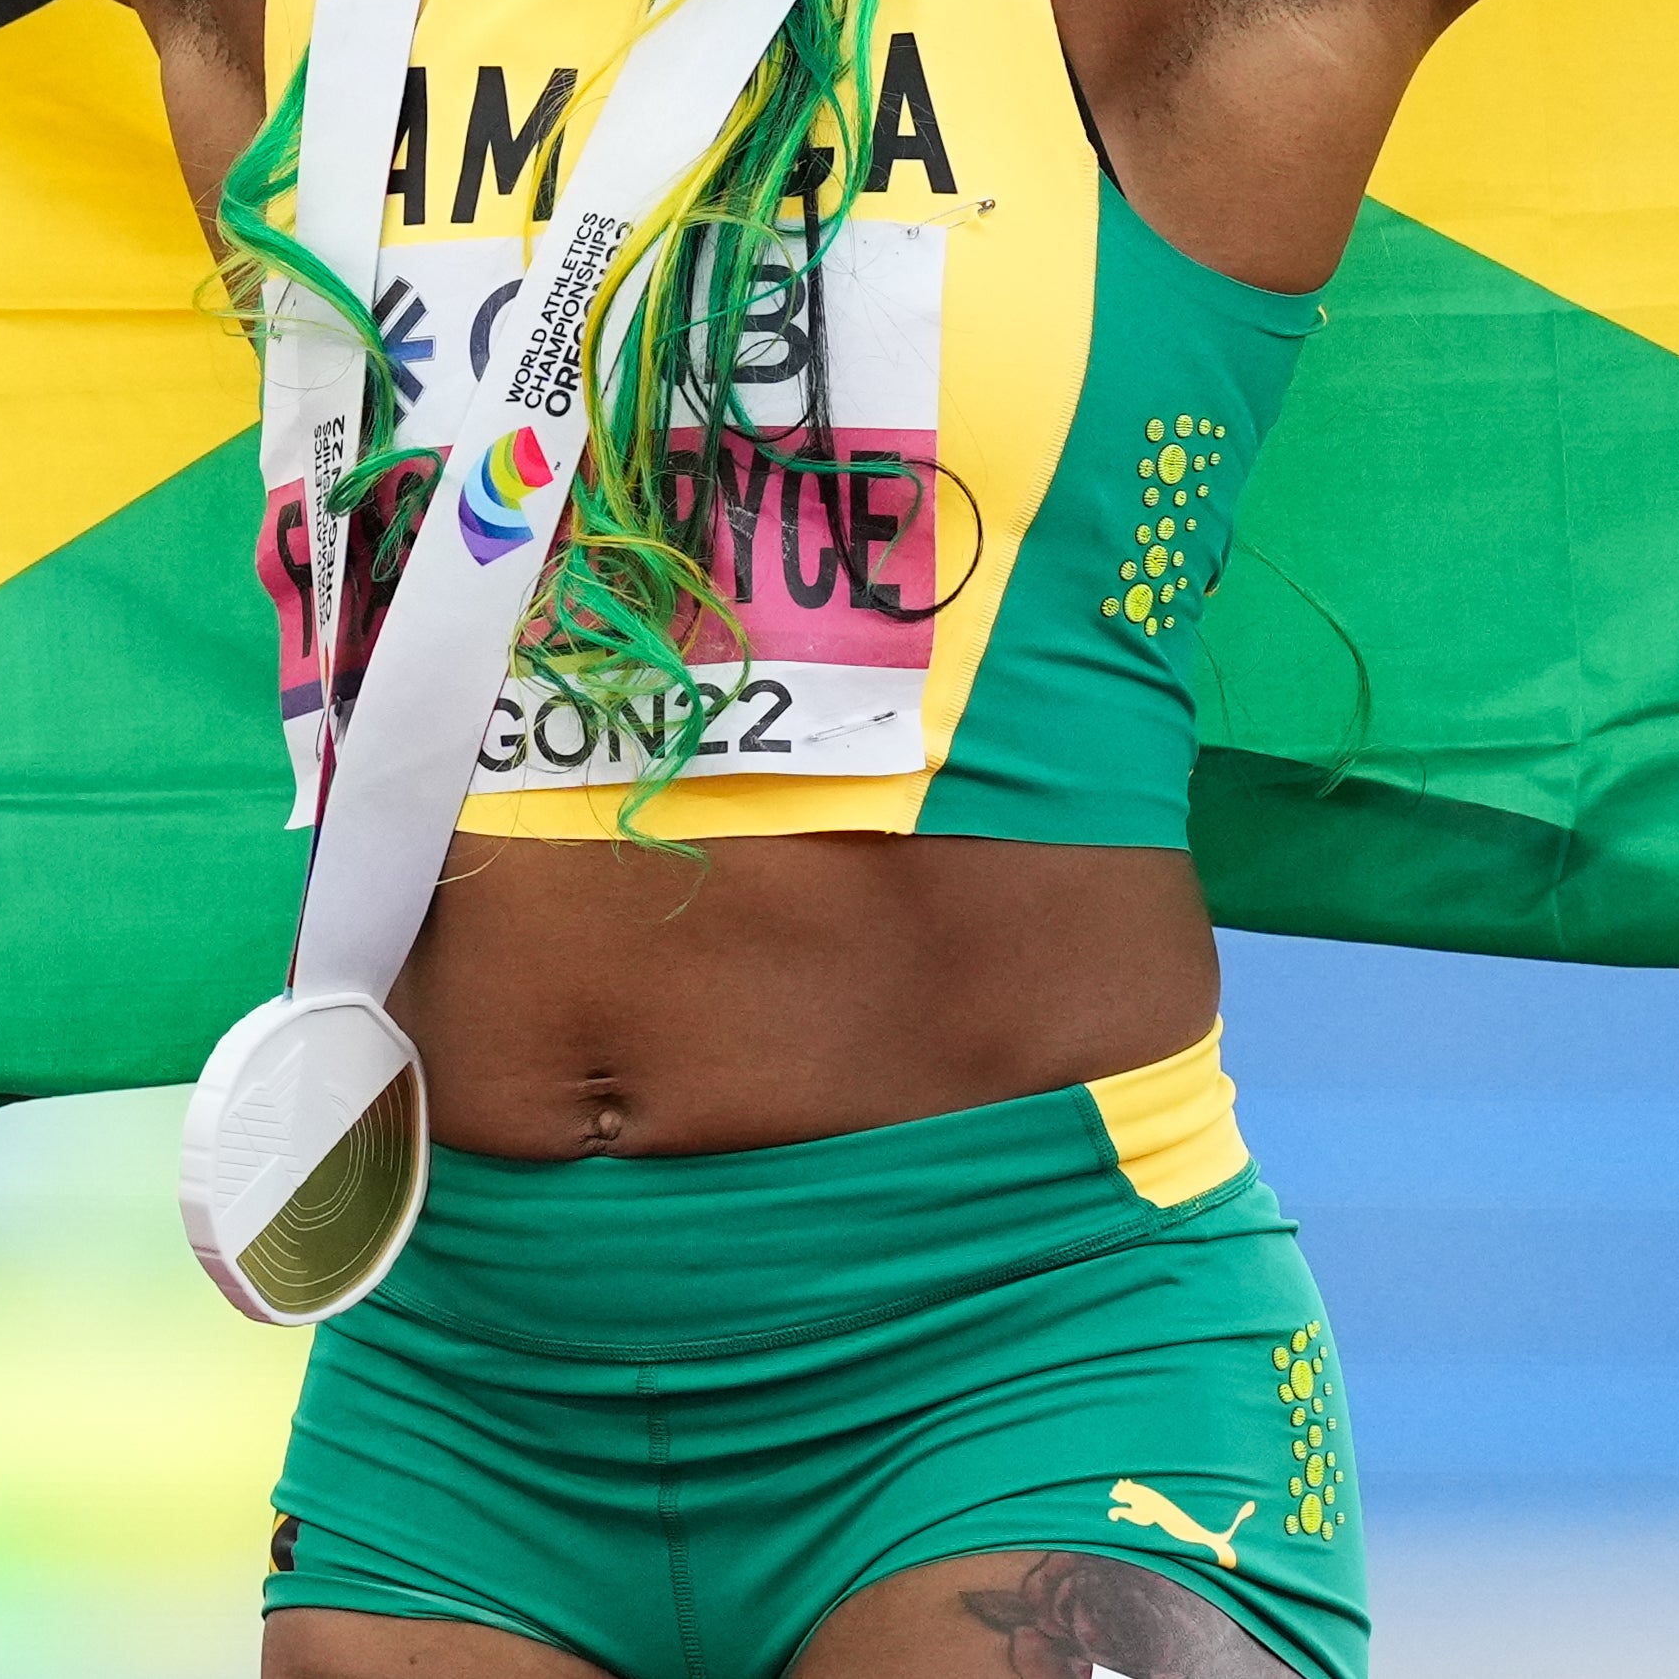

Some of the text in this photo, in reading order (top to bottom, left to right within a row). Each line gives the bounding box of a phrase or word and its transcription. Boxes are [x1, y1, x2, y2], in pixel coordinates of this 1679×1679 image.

[505, 212, 598, 403] WORLD ATHLETICS
[524, 217, 616, 409] CHAMPIONSHIPS
[325, 414, 345, 622] OREGN22
